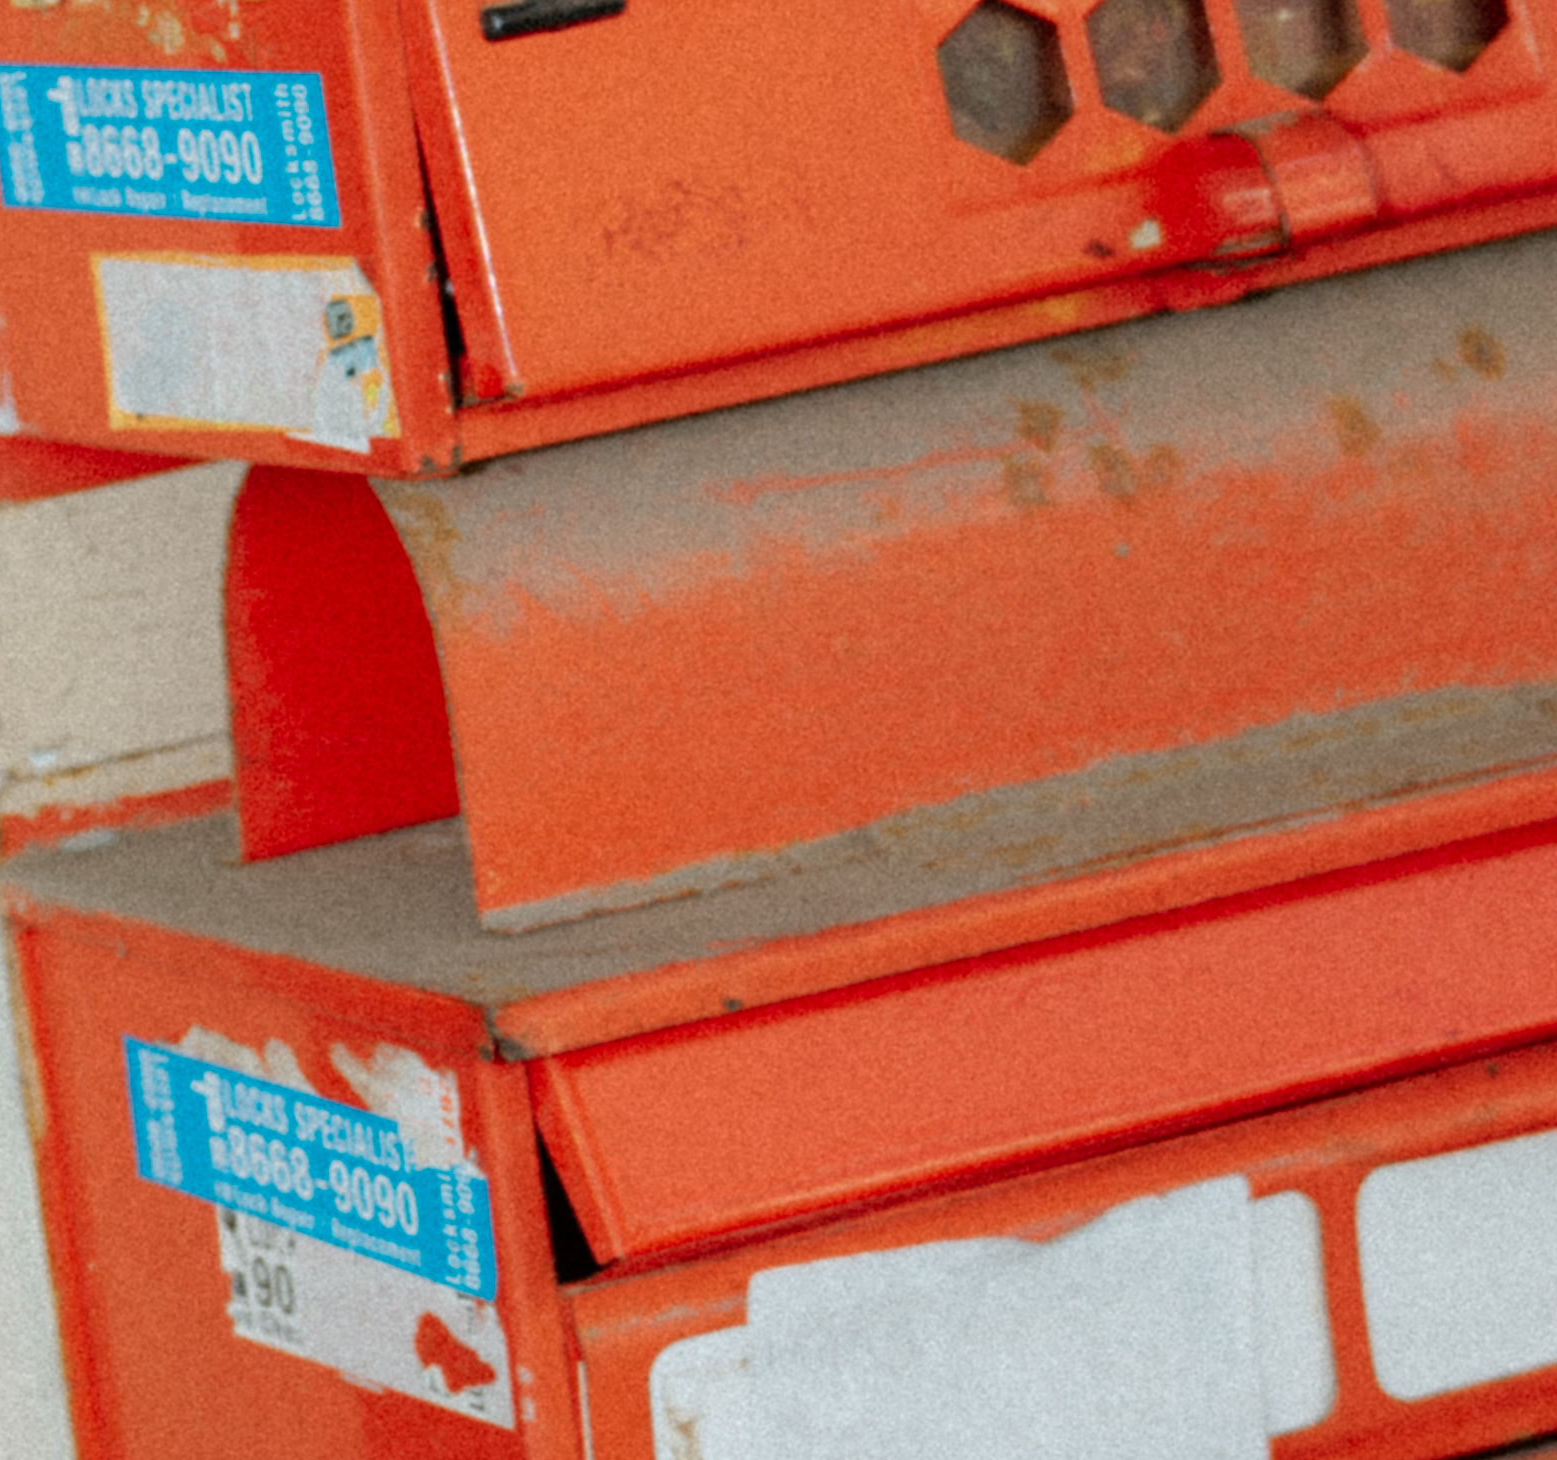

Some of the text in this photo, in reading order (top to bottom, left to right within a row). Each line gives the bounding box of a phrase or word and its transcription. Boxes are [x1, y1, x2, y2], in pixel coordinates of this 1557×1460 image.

[140, 78, 255, 123] SPECIALIST
[81, 123, 264, 185] 8668-9090
[273, 83, 308, 221] Locksmith
[228, 1124, 419, 1237] 8668-9090
